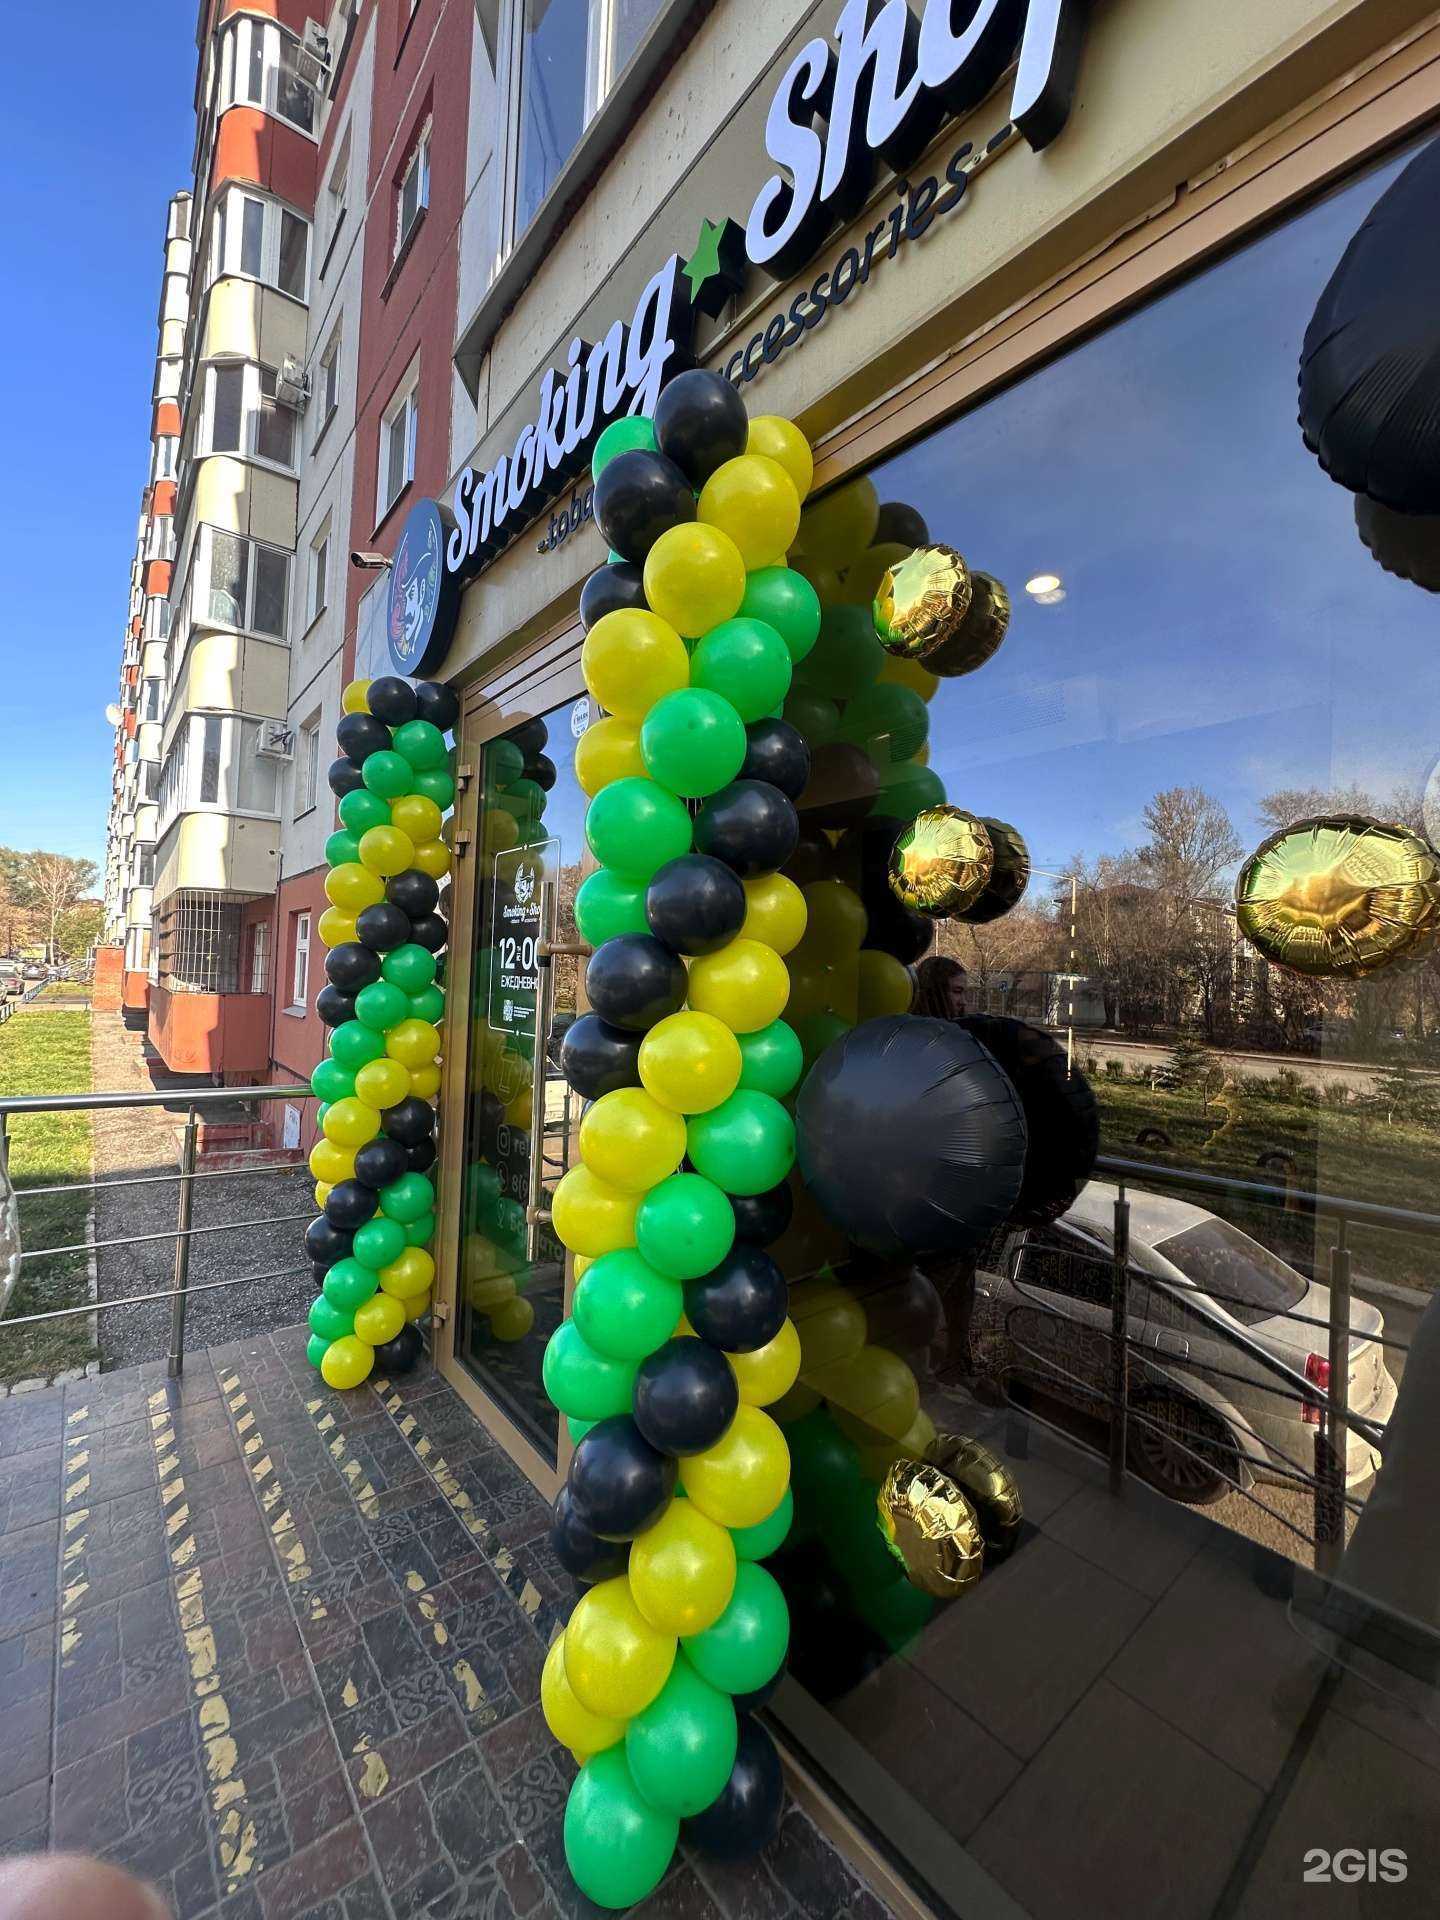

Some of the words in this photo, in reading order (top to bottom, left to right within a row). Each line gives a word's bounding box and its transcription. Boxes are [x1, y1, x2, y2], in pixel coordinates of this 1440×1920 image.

[447, 253, 675, 572] Smoking
[745, 0, 1063, 264] Sho
[547, 485, 595, 551] toba
[718, 142, 974, 391] ccessories
